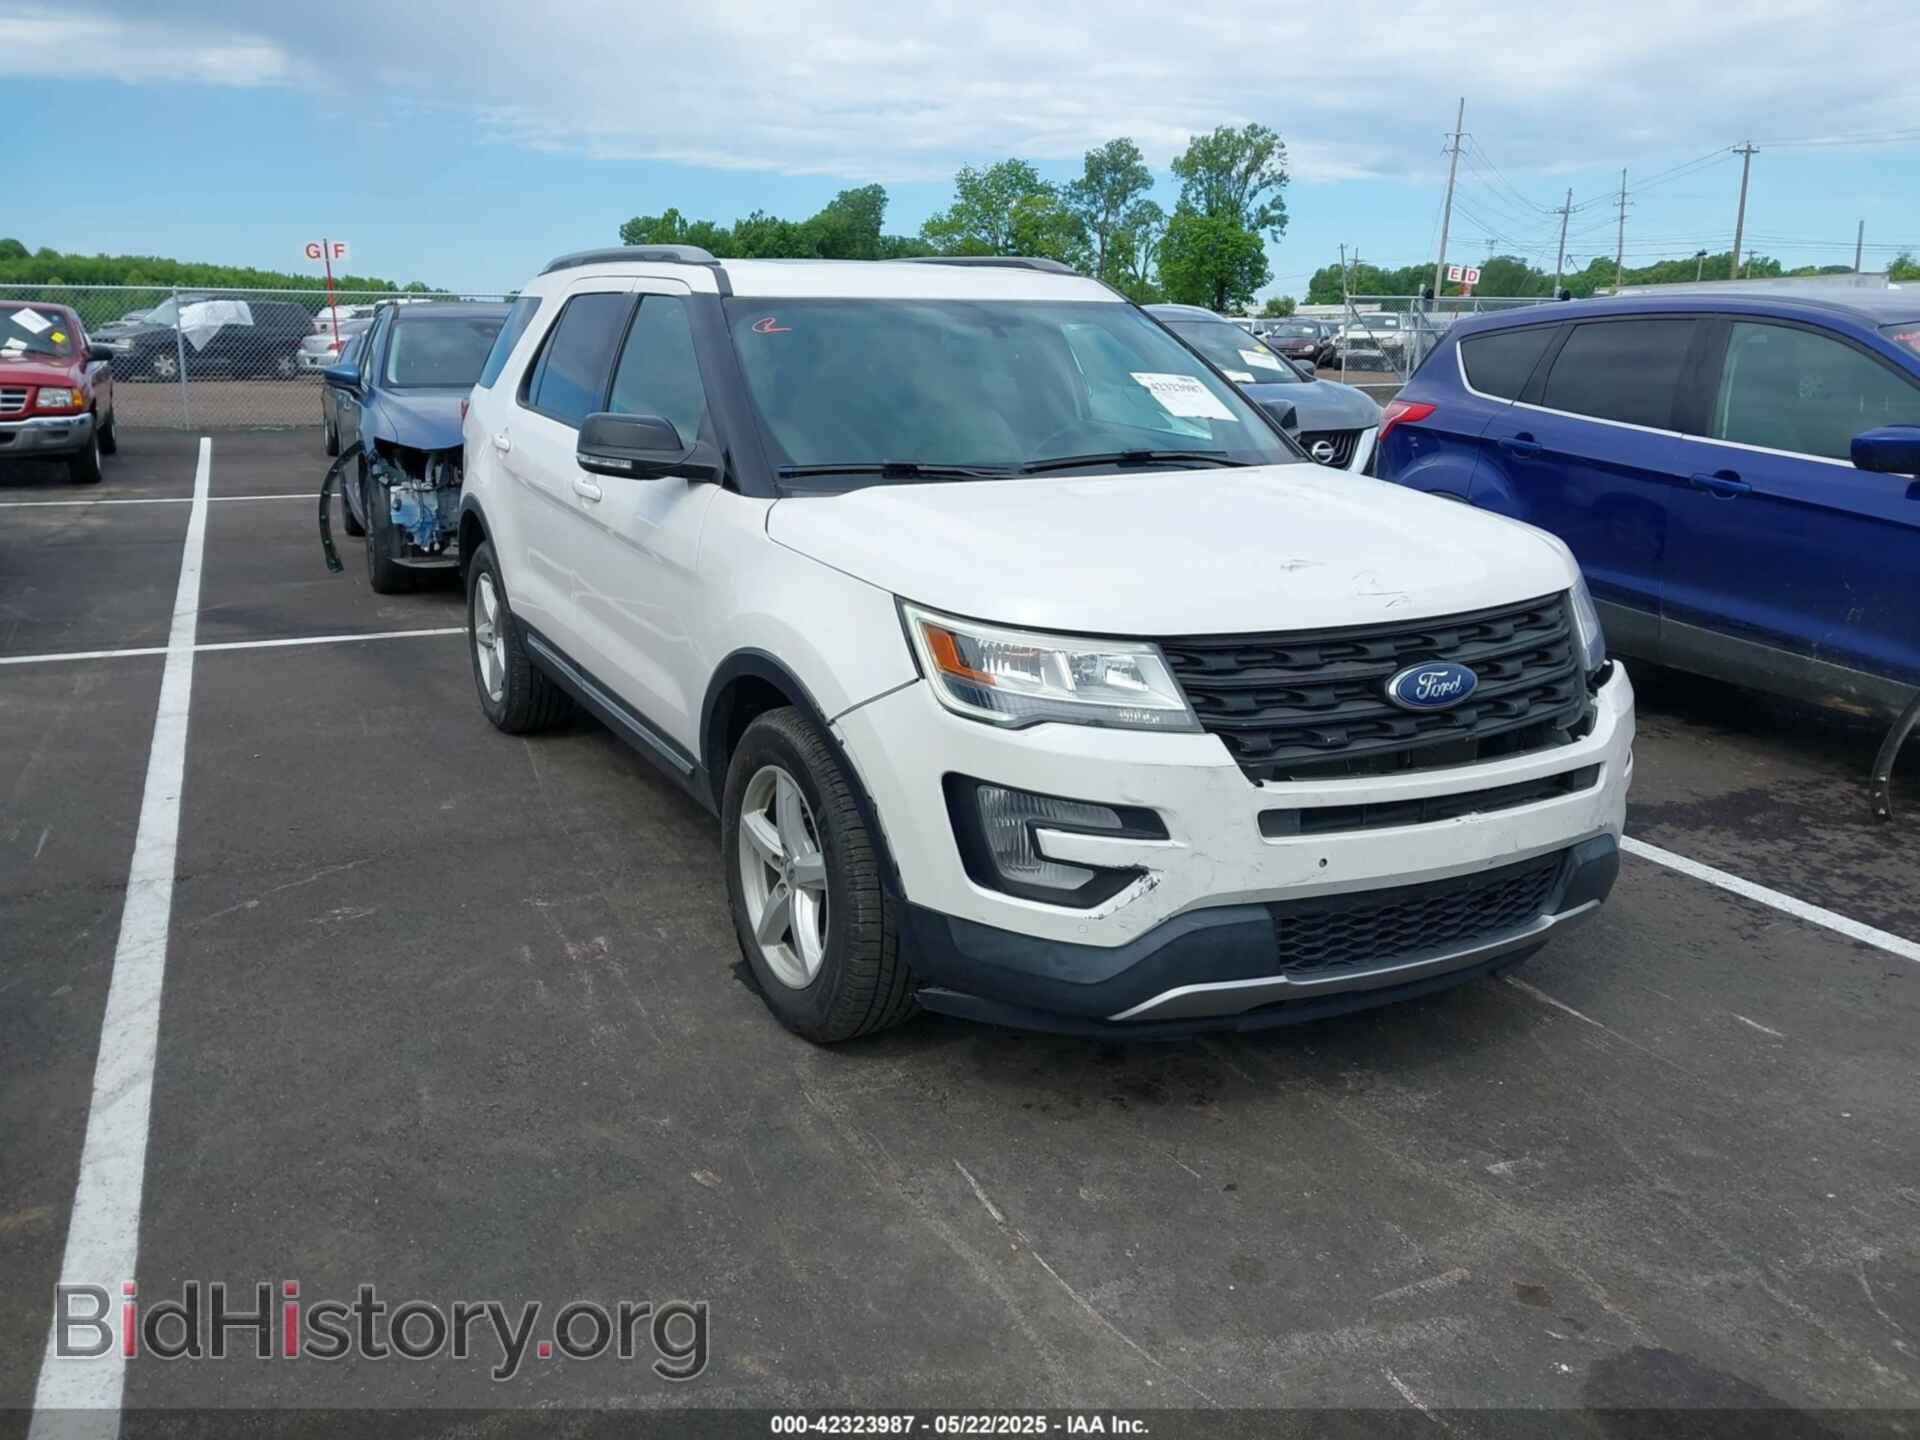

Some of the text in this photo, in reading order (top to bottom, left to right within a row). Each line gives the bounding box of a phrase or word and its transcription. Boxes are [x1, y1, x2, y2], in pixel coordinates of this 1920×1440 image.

[305, 243, 345, 259] G F
[1450, 267, 1478, 282] E D
[1416, 671, 1462, 700] Ford
